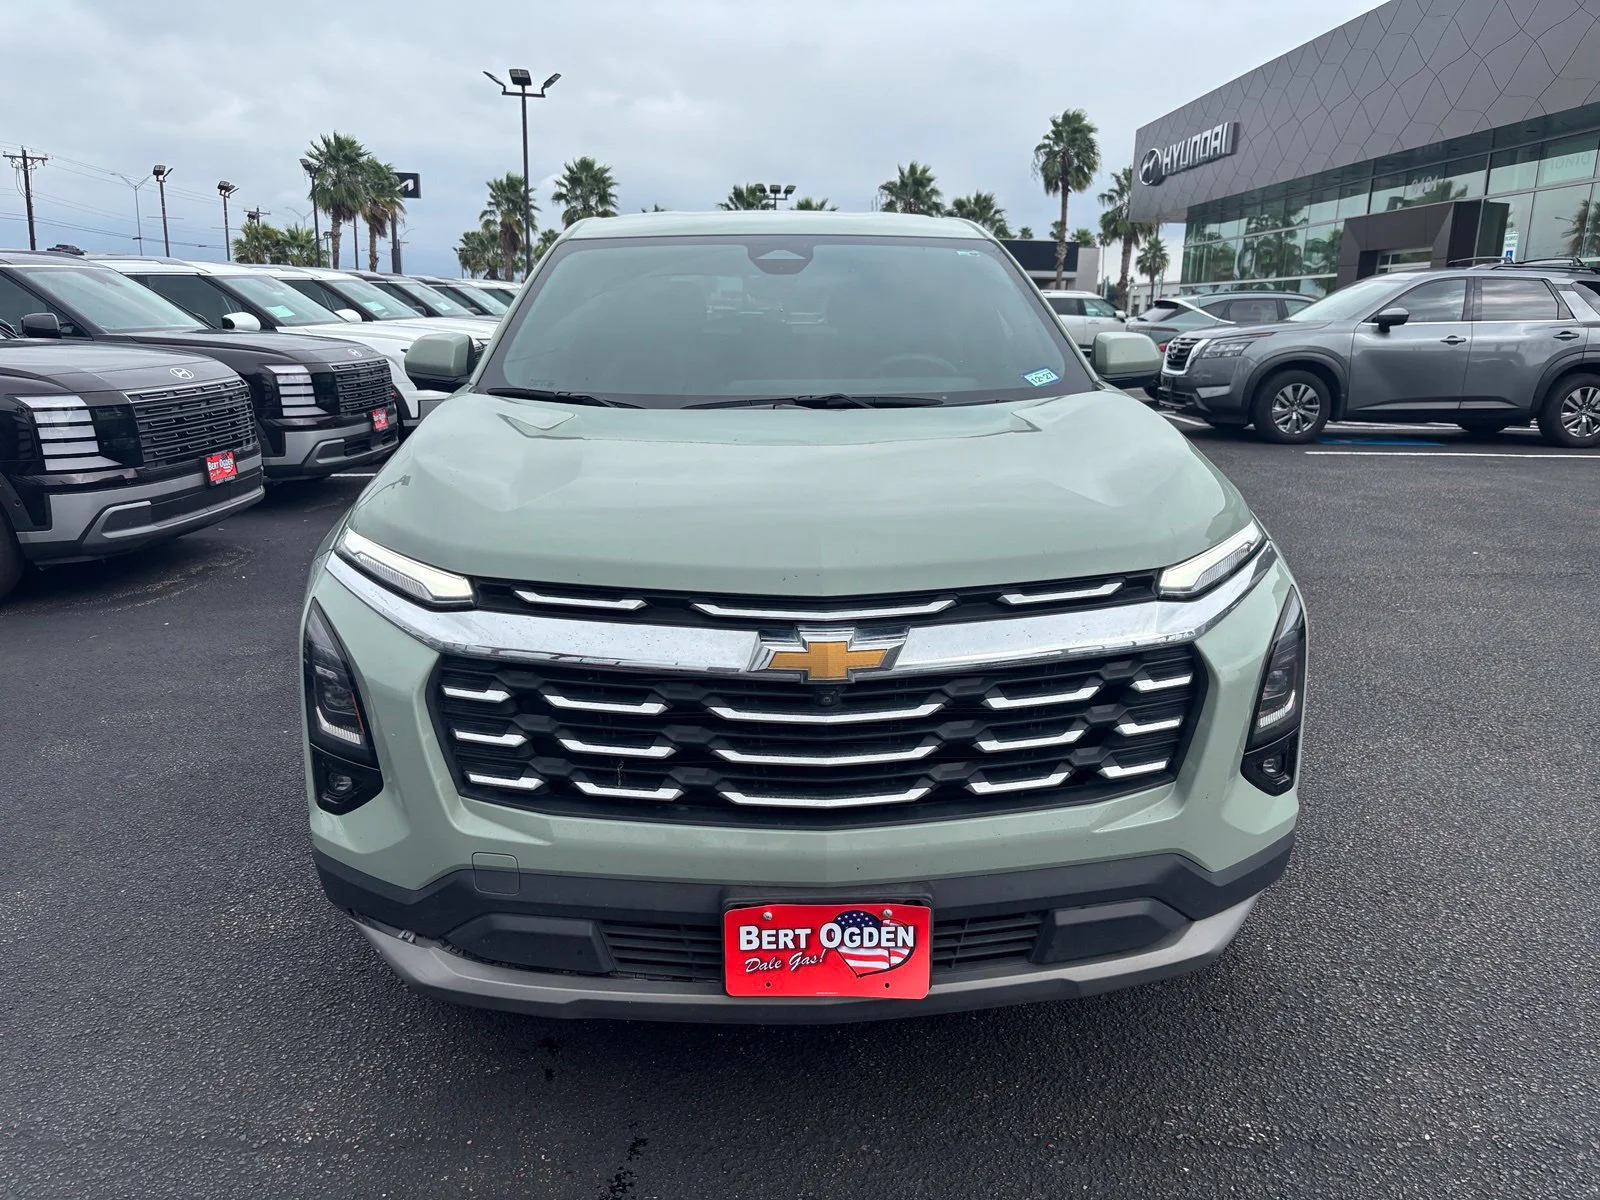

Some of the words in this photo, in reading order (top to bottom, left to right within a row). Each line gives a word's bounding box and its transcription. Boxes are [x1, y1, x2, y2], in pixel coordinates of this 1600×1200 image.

[1162, 122, 1230, 175] HYUNDAI
[738, 925, 812, 951] BERT
[819, 922, 915, 949] OGDEN
[744, 956, 782, 973] Dale
[788, 948, 827, 971] Gas!
